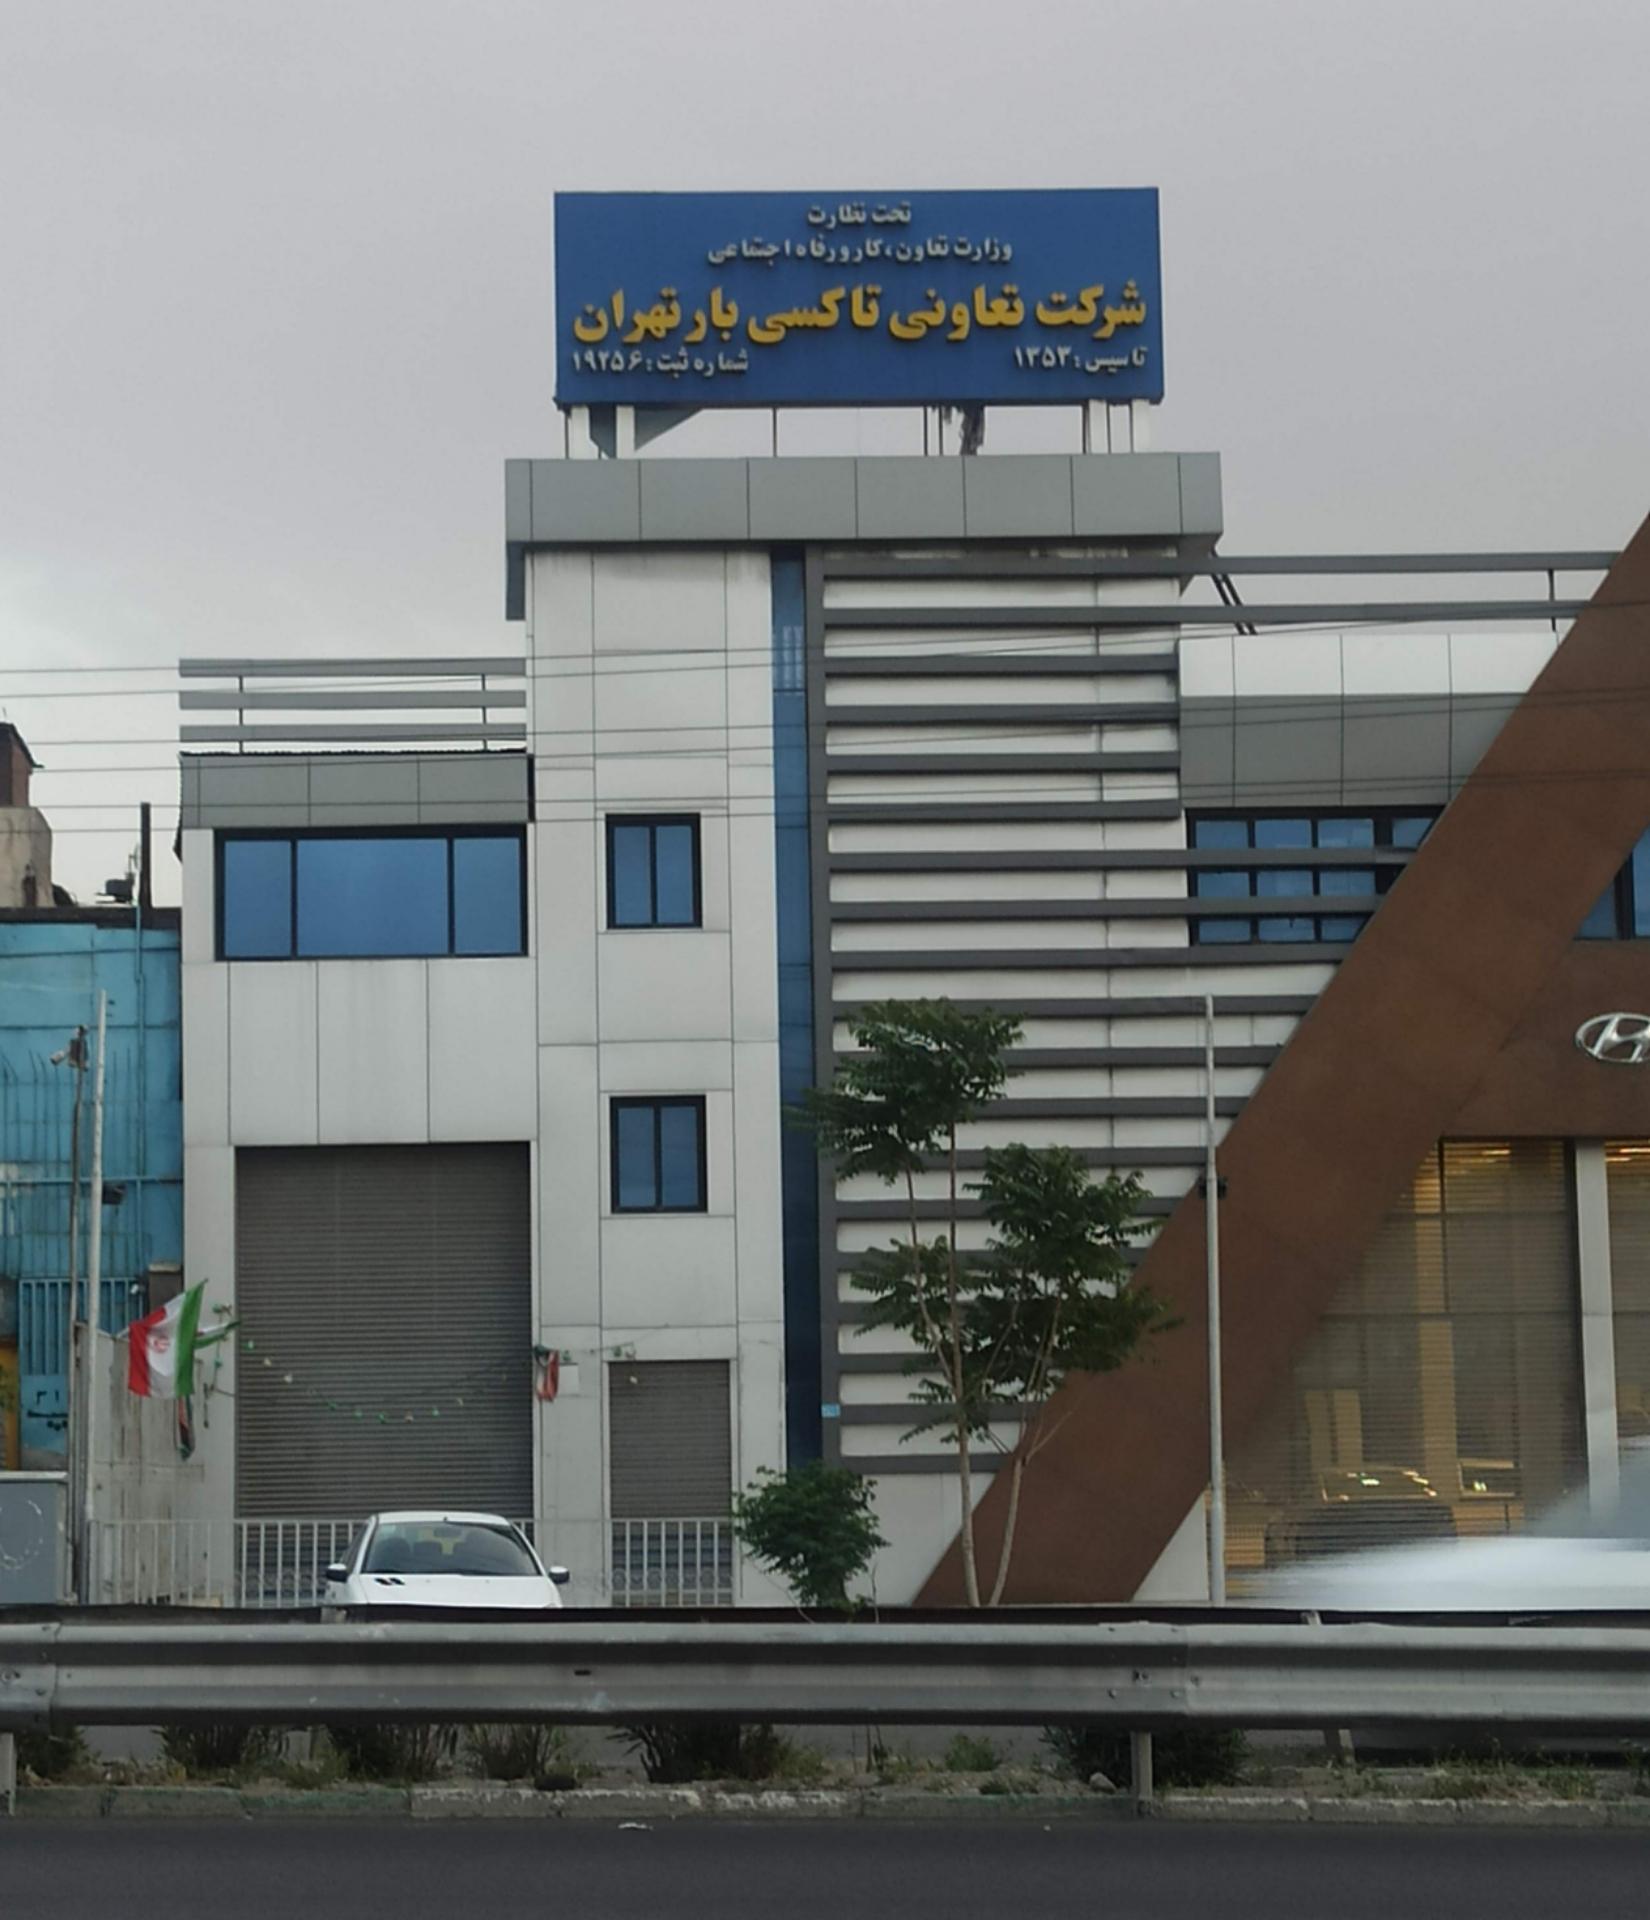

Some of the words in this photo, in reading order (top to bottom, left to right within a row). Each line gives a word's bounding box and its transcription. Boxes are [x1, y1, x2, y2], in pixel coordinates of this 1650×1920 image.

[807, 202, 867, 229] نظارت
[871, 202, 913, 224] تحت
[707, 236, 791, 267] اجتماعی
[954, 236, 1013, 262] وزارت
[572, 286, 682, 343] تهران
[684, 287, 740, 344] بار
[888, 284, 1026, 340] تعاونی
[1034, 279, 1147, 339] شرکت
[693, 347, 749, 376] شماره
